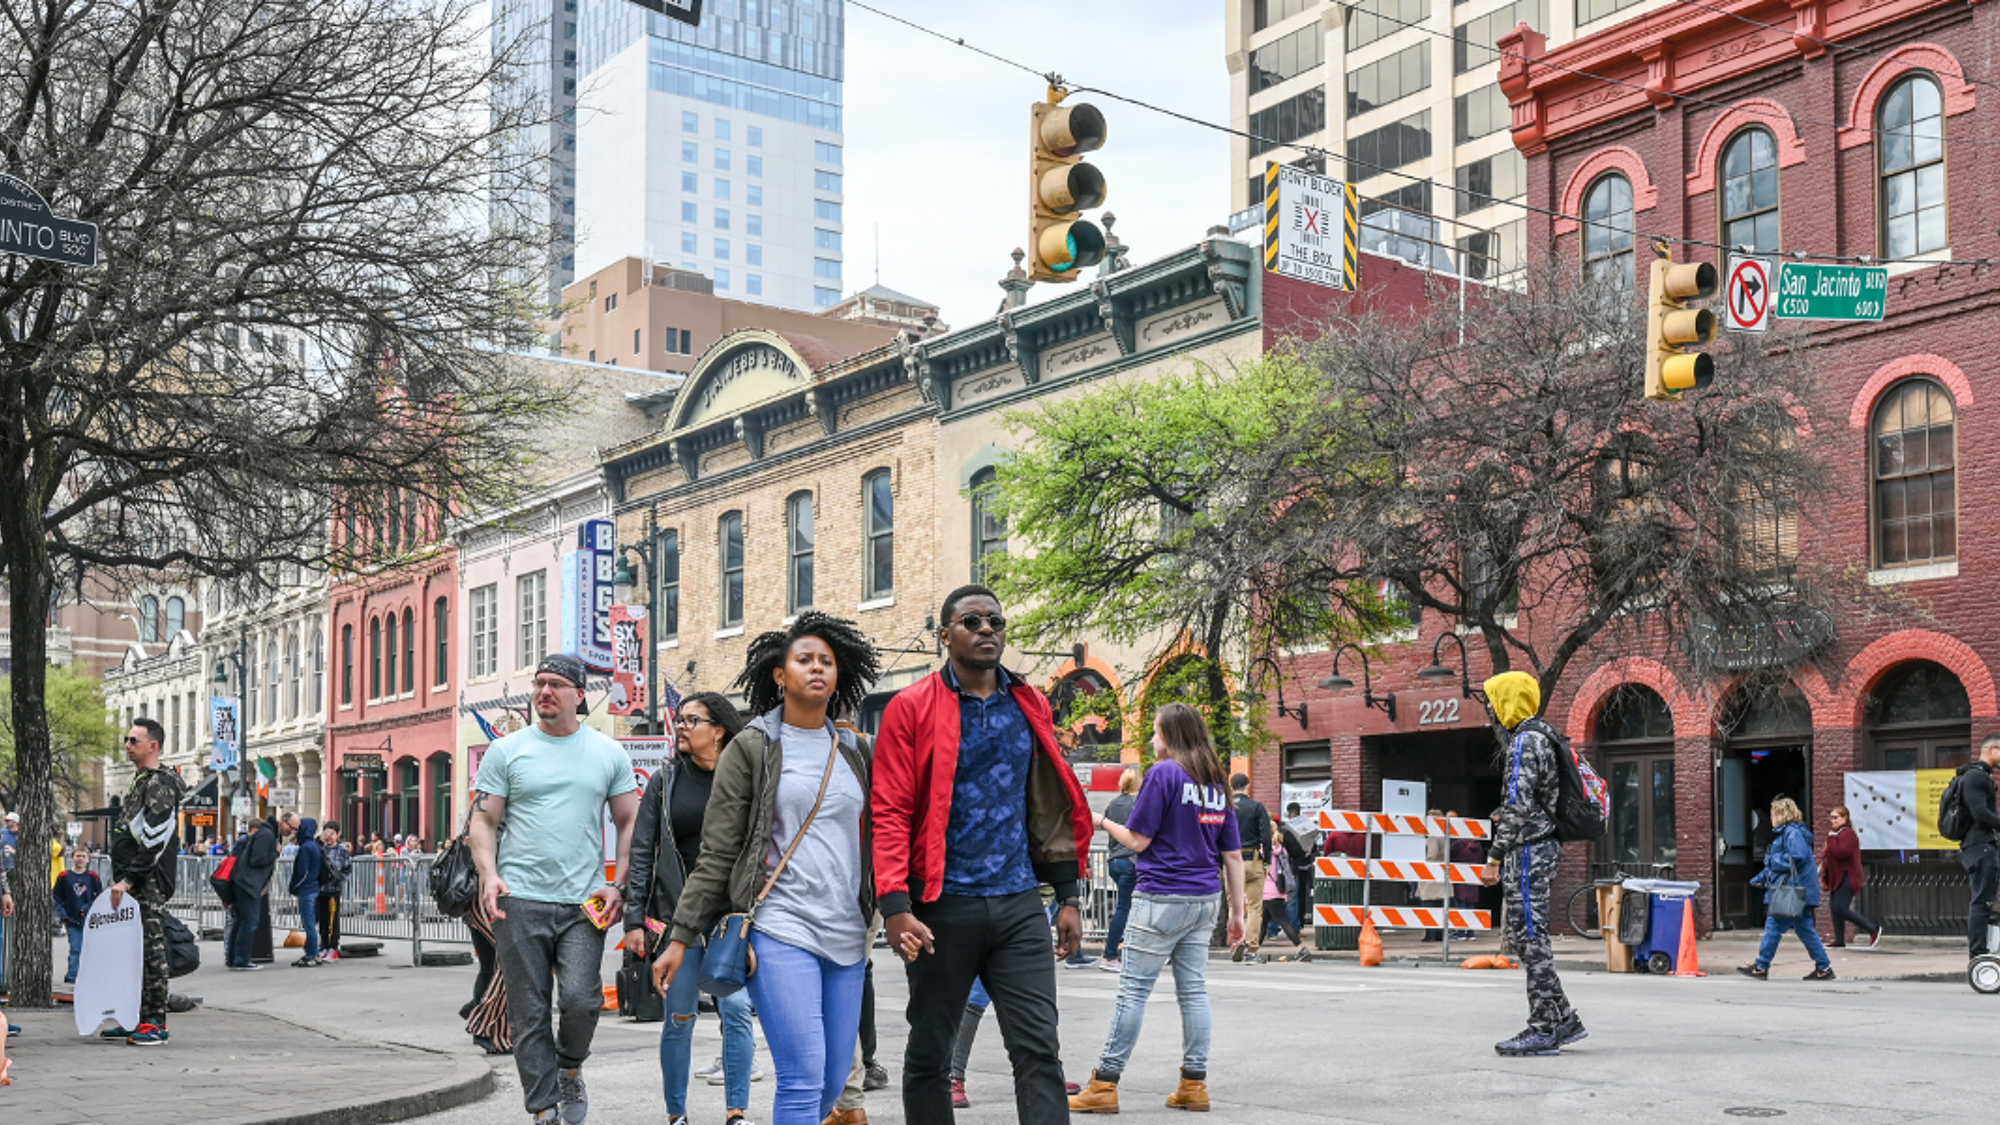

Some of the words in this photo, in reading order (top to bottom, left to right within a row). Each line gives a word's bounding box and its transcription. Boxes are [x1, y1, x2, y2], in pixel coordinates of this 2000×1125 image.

[1310, 182, 1342, 197] BLOCK
[1, 196, 42, 212] DISTRICT
[60, 229, 91, 244] BLVD
[62, 243, 86, 257] 500
[1290, 243, 1308, 260] THE
[1312, 250, 1333, 267] BOX
[1293, 262, 1303, 274] TO
[1781, 268, 1808, 295] San
[1811, 269, 1861, 297] Jacinto
[1865, 271, 1886, 289] BLVD
[1789, 299, 1809, 314] 500
[1854, 301, 1874, 316] 600
[725, 350, 757, 381] WEBB
[613, 624, 635, 641] SX
[588, 649, 612, 663] SPOR
[616, 641, 640, 659] SW
[1419, 699, 1460, 724] 222
